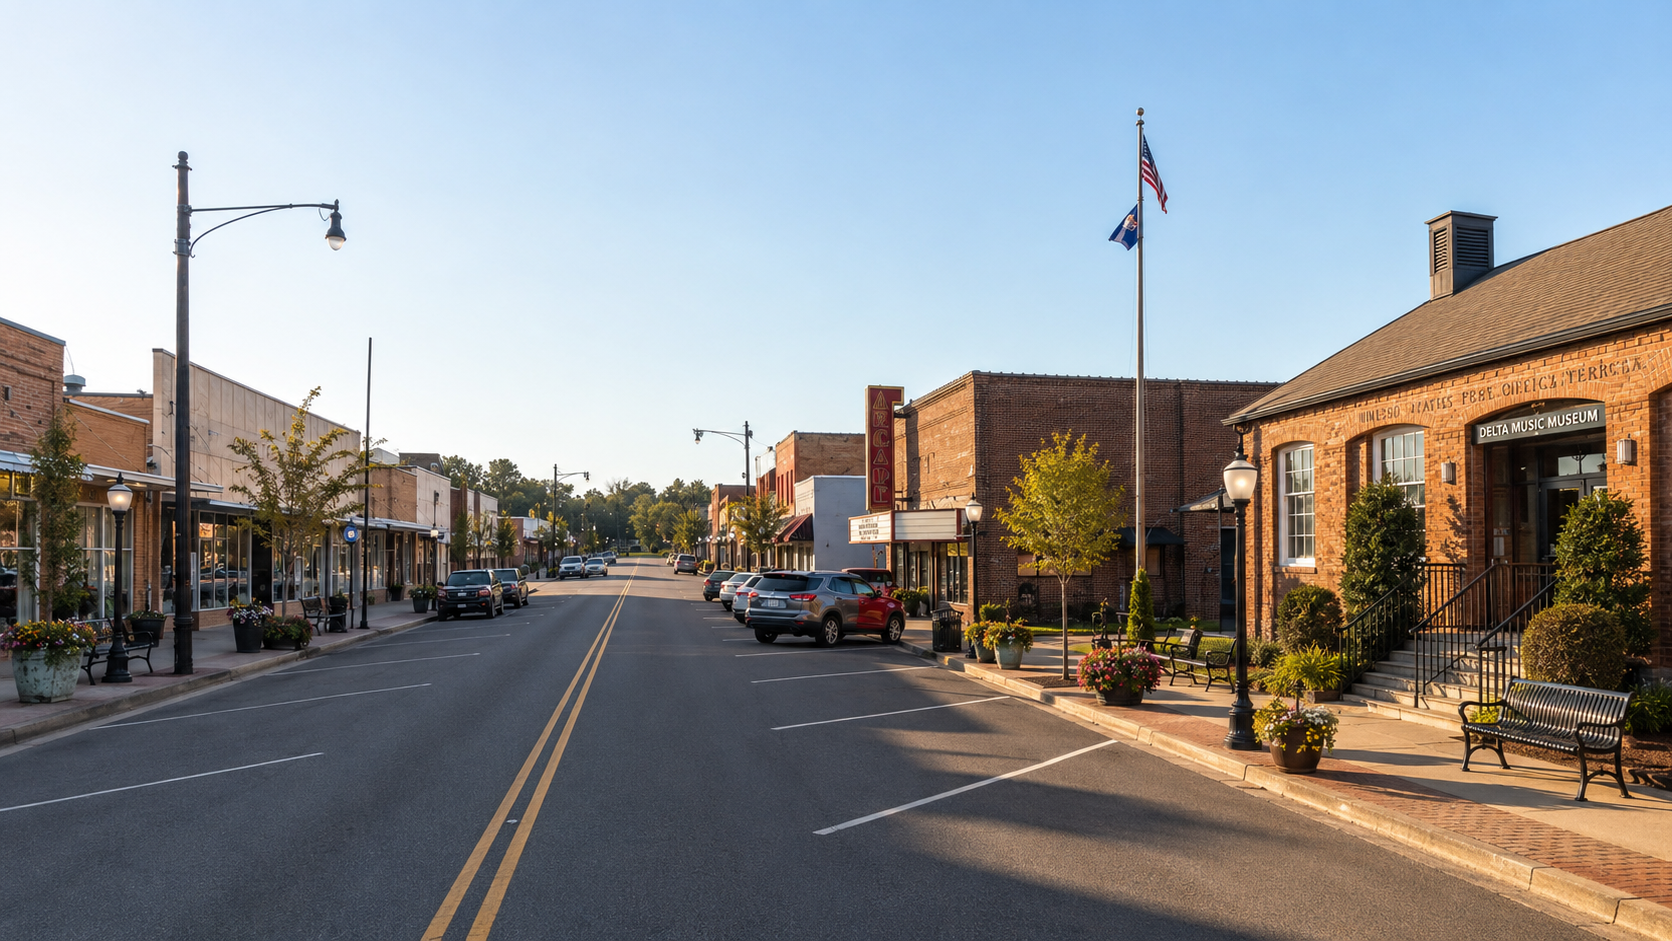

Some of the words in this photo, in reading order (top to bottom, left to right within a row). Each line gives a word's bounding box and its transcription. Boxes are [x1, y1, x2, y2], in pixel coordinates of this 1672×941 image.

[1479, 424, 1508, 438] DELTA
[1511, 418, 1545, 434] MUSIC
[1548, 409, 1599, 428] MUSEUM
